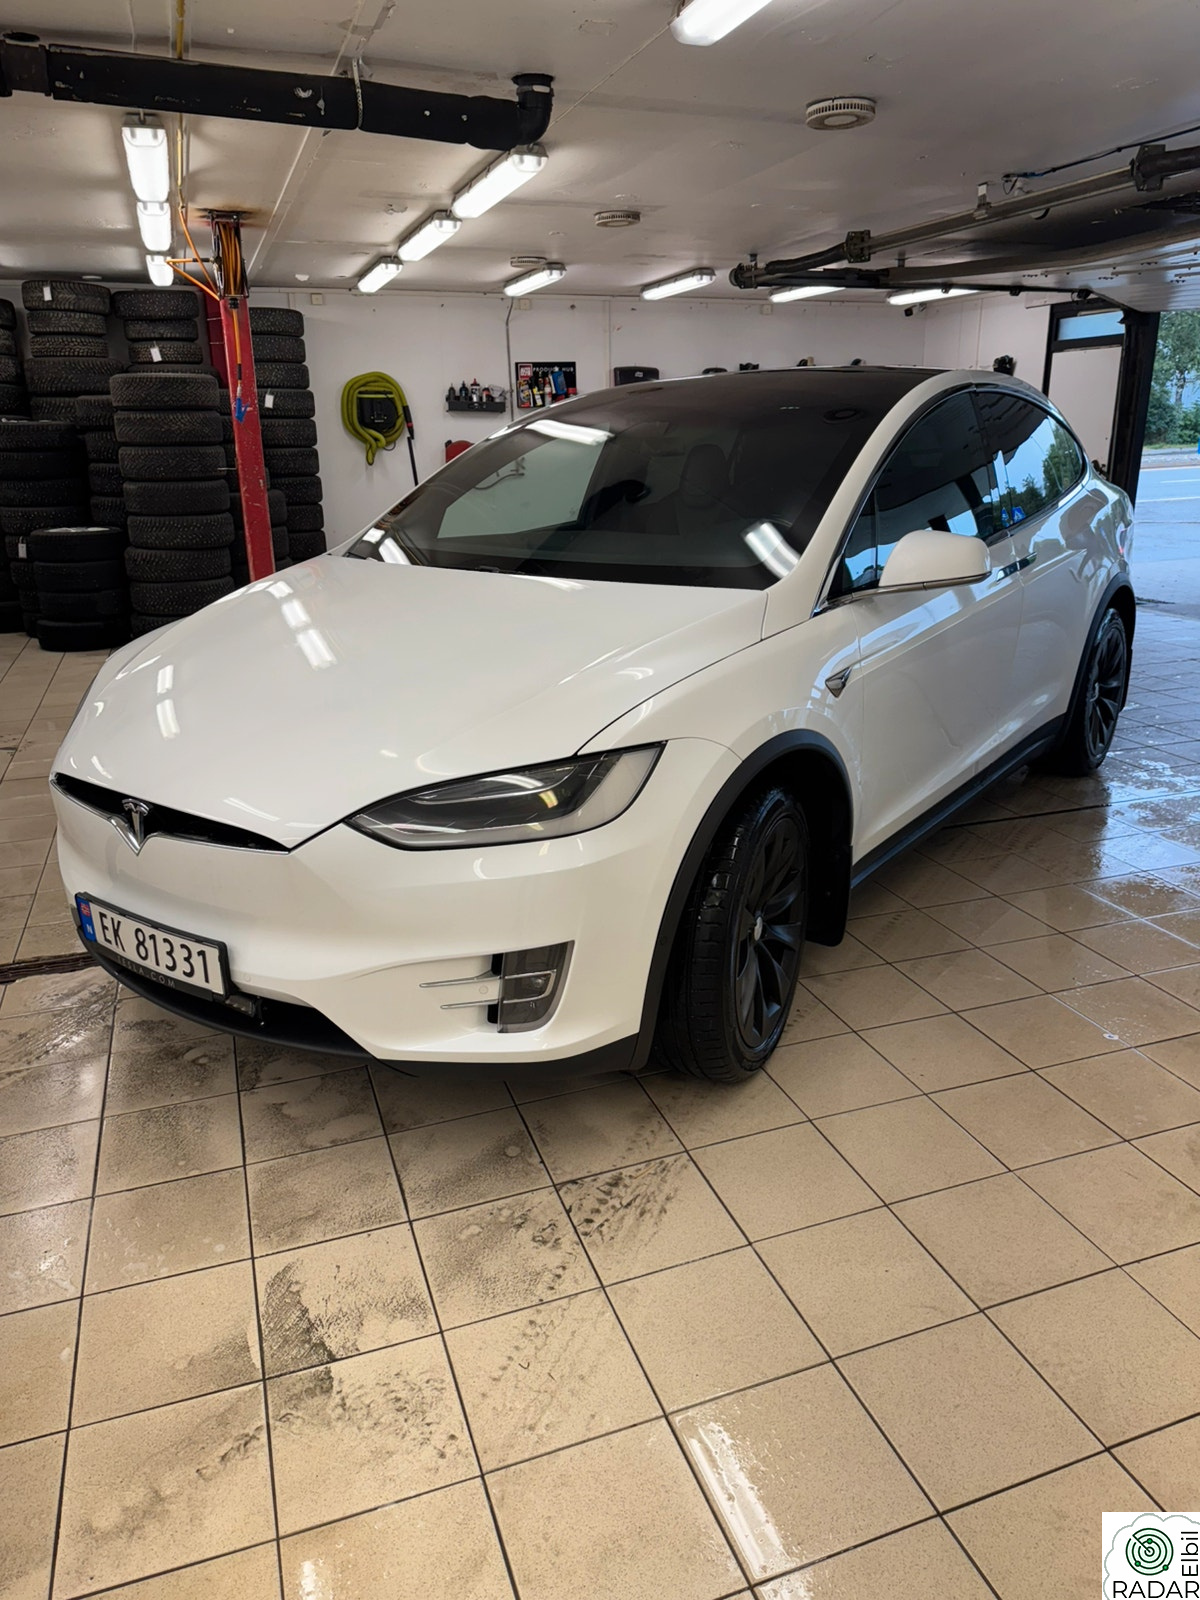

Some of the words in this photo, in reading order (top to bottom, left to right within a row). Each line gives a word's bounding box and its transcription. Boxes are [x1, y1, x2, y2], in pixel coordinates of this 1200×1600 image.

[86, 924, 93, 935] N
[99, 911, 126, 952] EK
[134, 928, 210, 984] 81331
[117, 956, 176, 989] TESLA.COM
